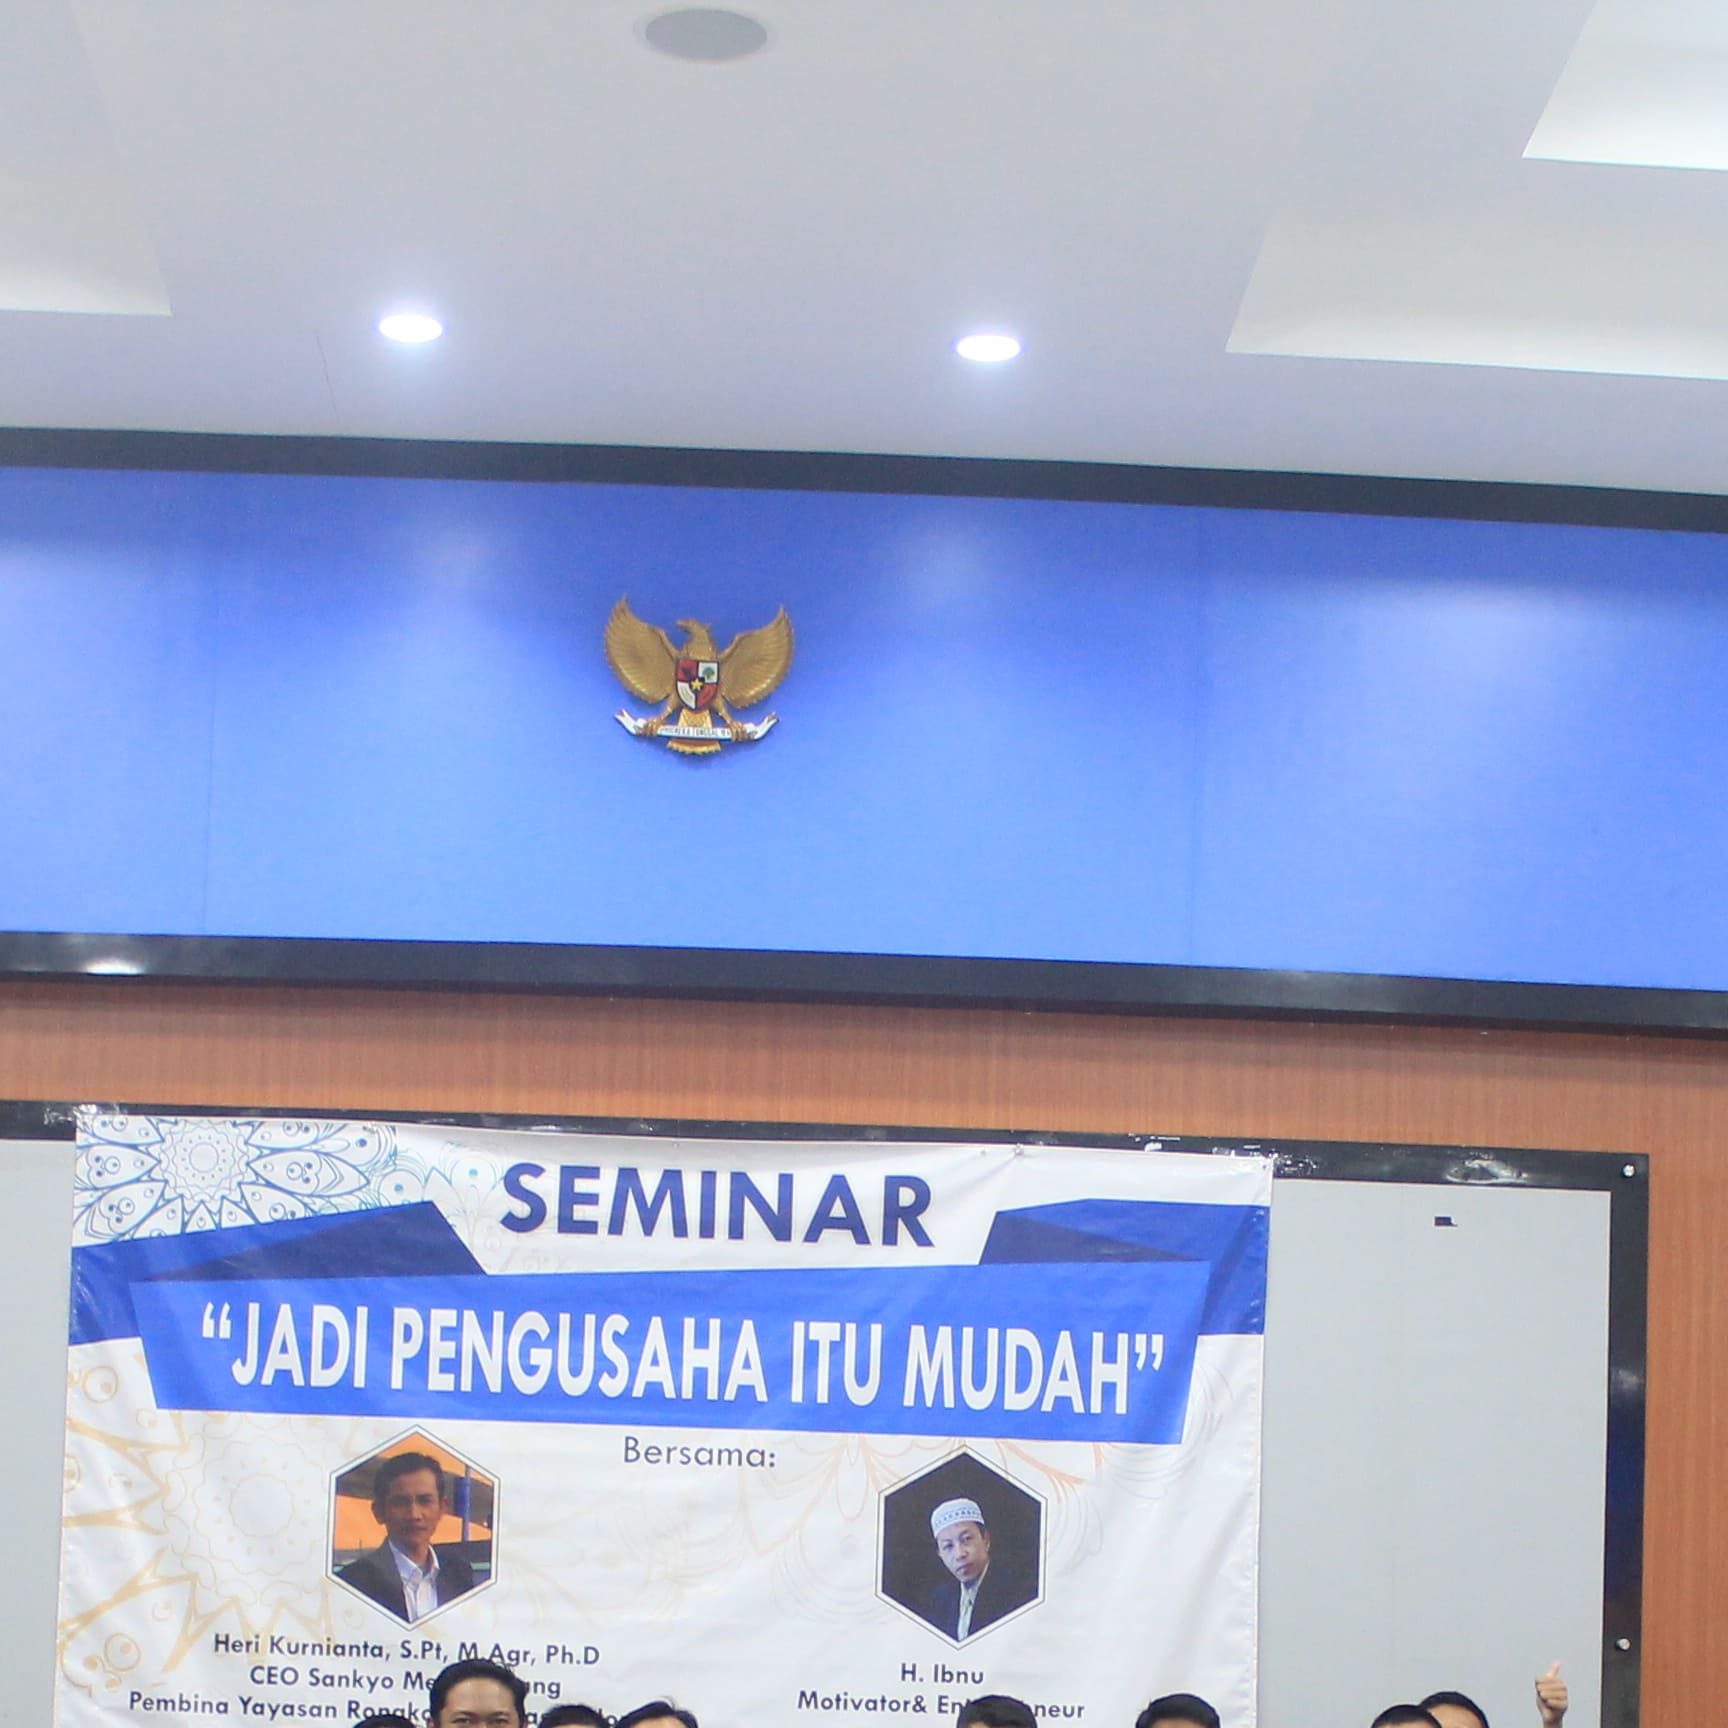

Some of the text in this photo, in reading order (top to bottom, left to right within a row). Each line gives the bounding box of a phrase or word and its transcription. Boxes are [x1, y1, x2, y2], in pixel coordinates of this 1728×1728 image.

[498, 1161, 935, 1248] SEMINAR
[201, 1302, 1165, 1415] “JADI PENGUSAHA ITU MUDAH”
[623, 1435, 776, 1469] Bersama:
[214, 1633, 260, 1654] Heri
[269, 1635, 391, 1663] Kurnianta,
[400, 1640, 449, 1663] S.Pt,
[546, 1644, 601, 1666] Ph.D
[249, 1665, 300, 1687] CEO
[308, 1667, 395, 1695] Sankyo
[900, 1663, 985, 1686] H. Ibnu
[129, 1690, 230, 1716] Pembina
[238, 1695, 338, 1722] Yayasan
